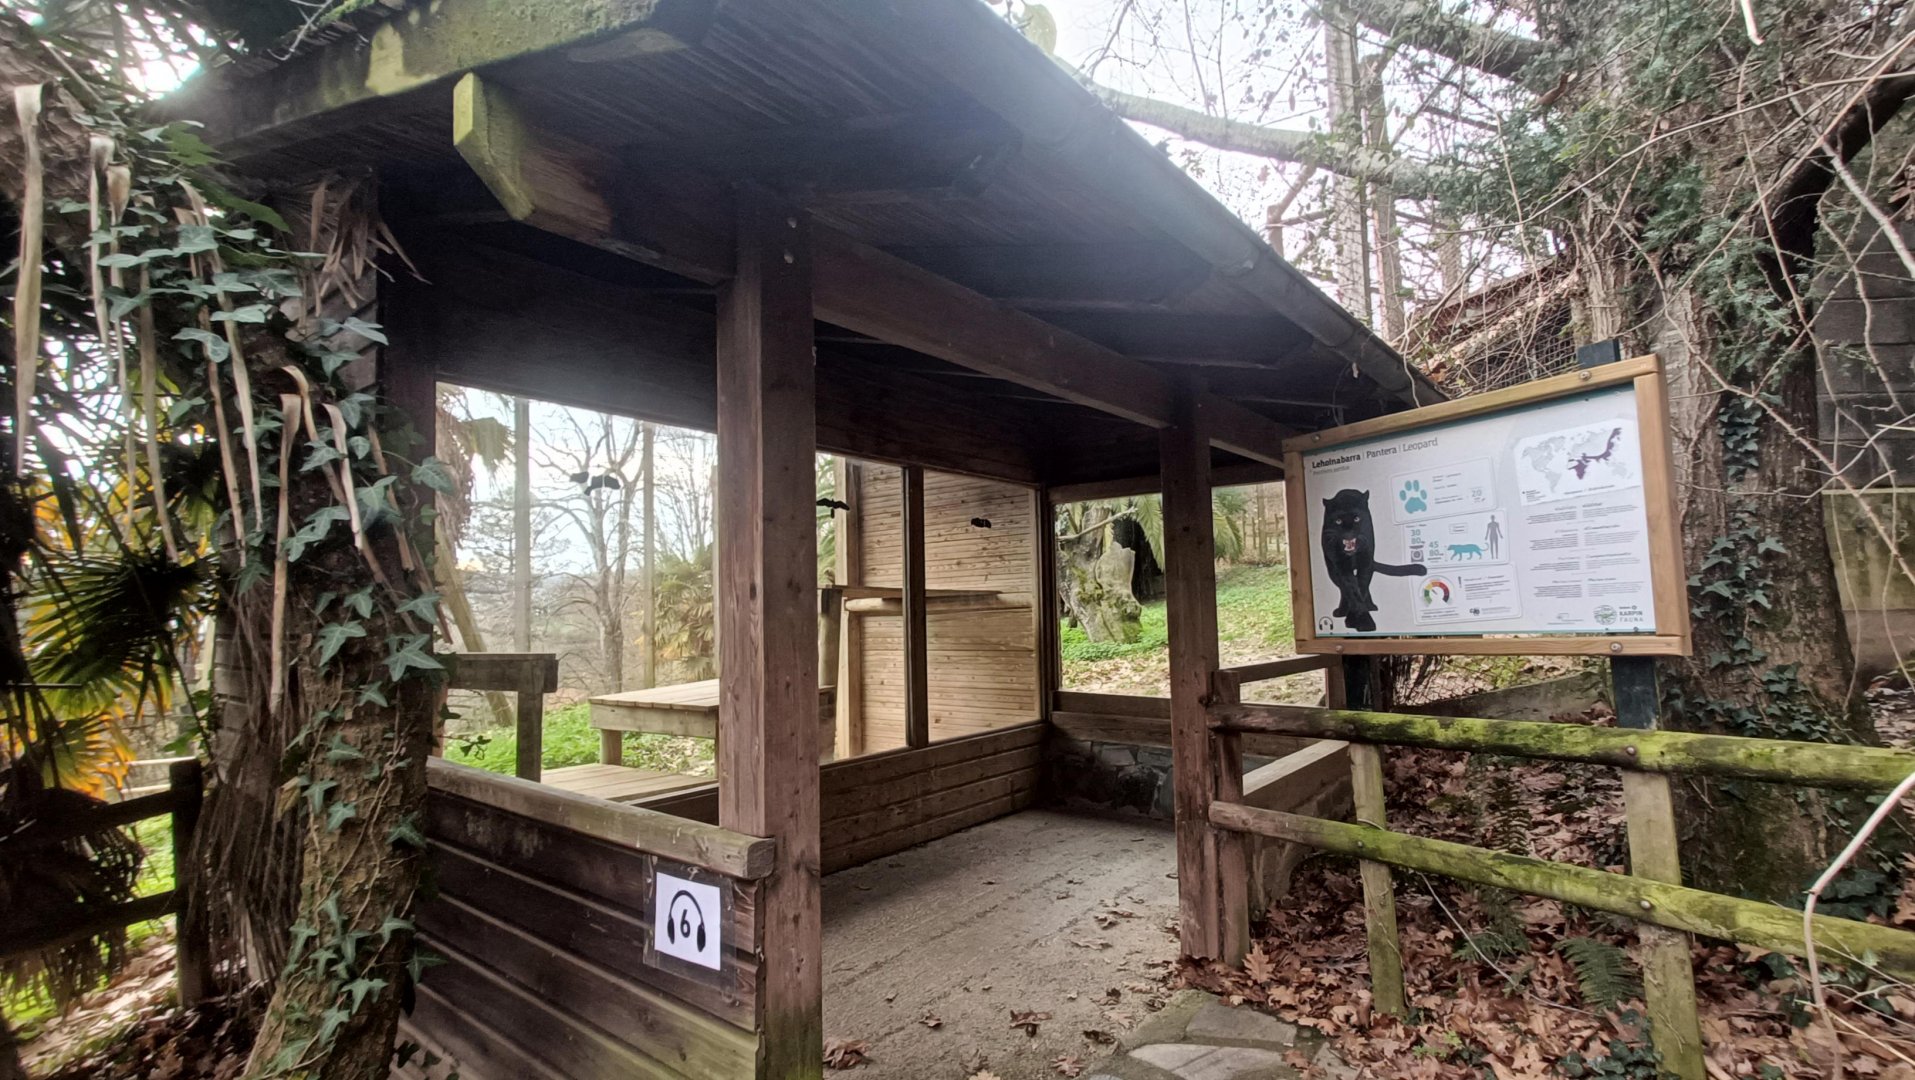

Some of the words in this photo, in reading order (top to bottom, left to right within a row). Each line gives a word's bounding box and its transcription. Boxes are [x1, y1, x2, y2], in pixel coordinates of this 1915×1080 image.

[1311, 453, 1361, 469] Lehoinabarra
[1366, 446, 1397, 459] Pantera
[1402, 437, 1438, 453] Leopard
[680, 908, 691, 938] 6
